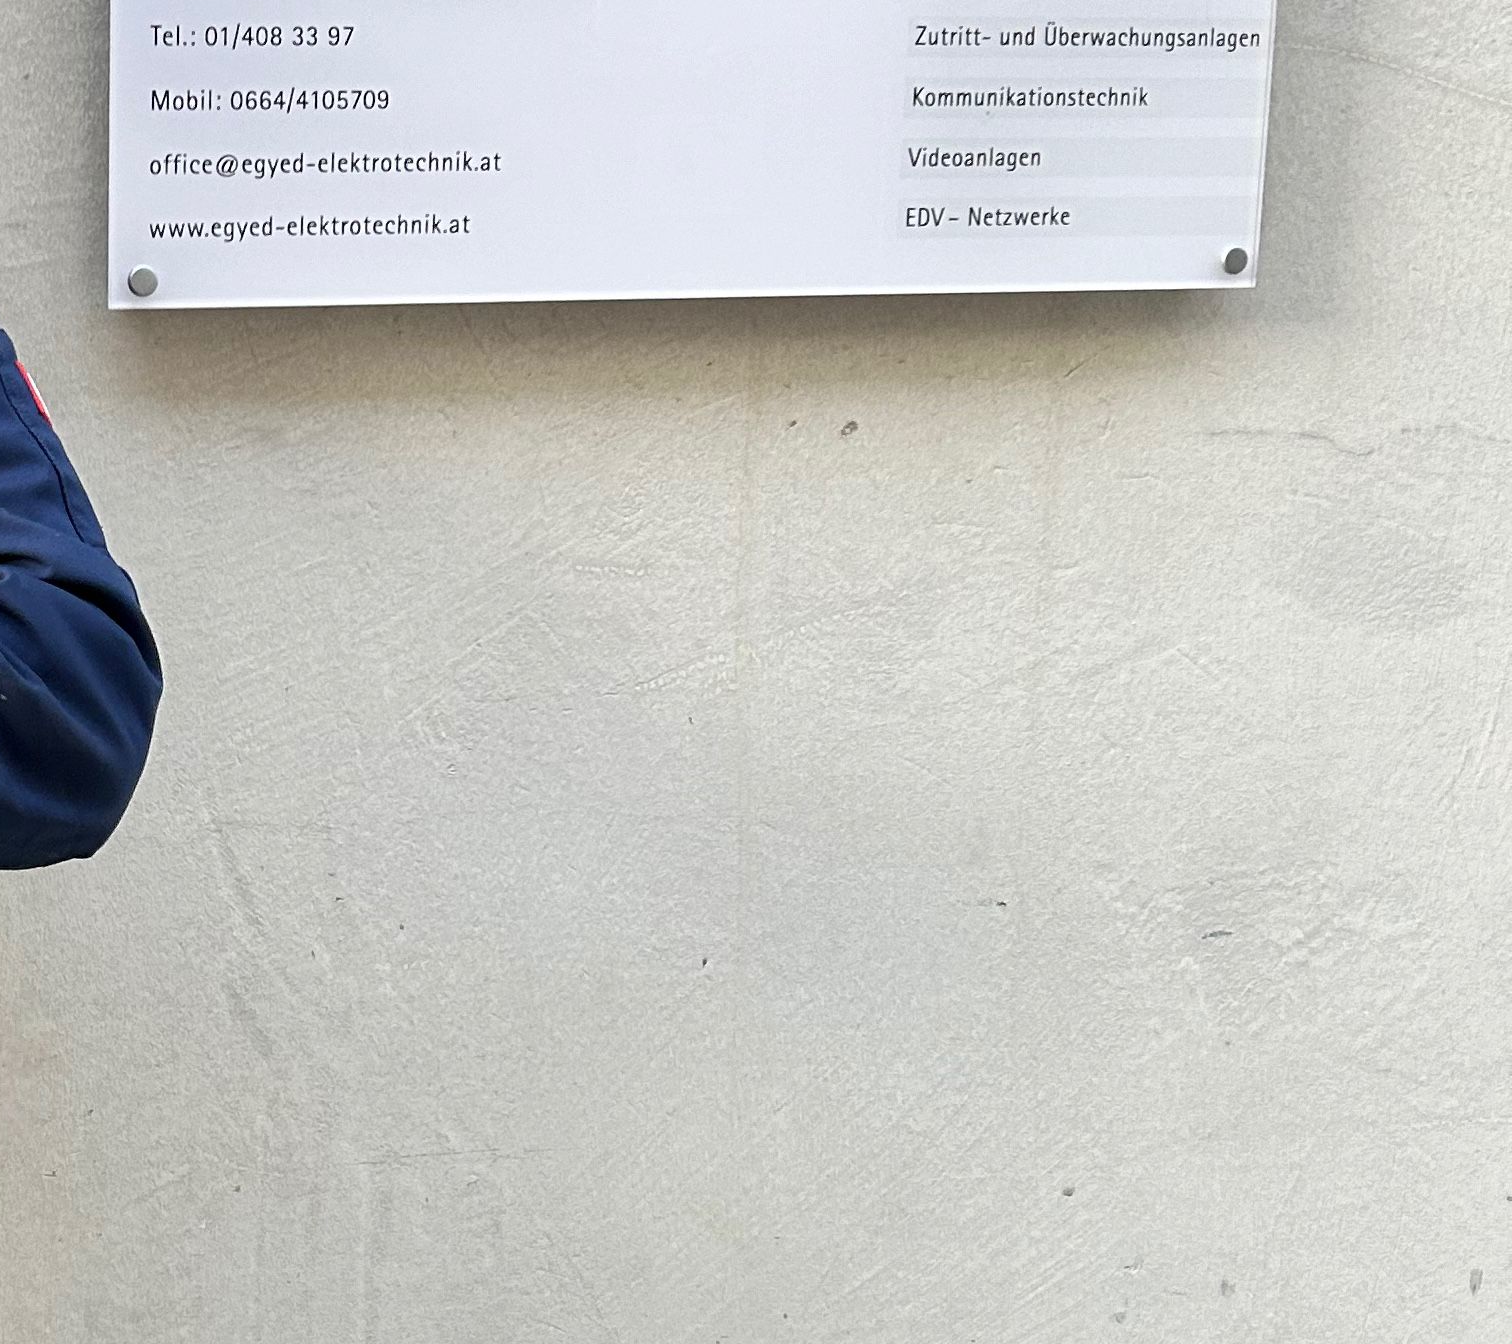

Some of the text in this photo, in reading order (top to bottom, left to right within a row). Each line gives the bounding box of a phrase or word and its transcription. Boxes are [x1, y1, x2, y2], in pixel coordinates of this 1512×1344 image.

[151, 23, 355, 51] Tel.: 01/408 33 97
[914, 21, 1260, 53] Zutritt- und Überwachungsanlagen
[150, 86, 390, 115] Mobil: 0664/4105709
[912, 86, 1149, 110] Kommunikationstechnik
[149, 150, 502, 180] office@egyed-elektrotechnik.at
[907, 146, 1042, 172] Videoanlagen
[149, 213, 471, 243] www.egyed-elektrotechnik.at
[967, 205, 1071, 227] Netzwerke
